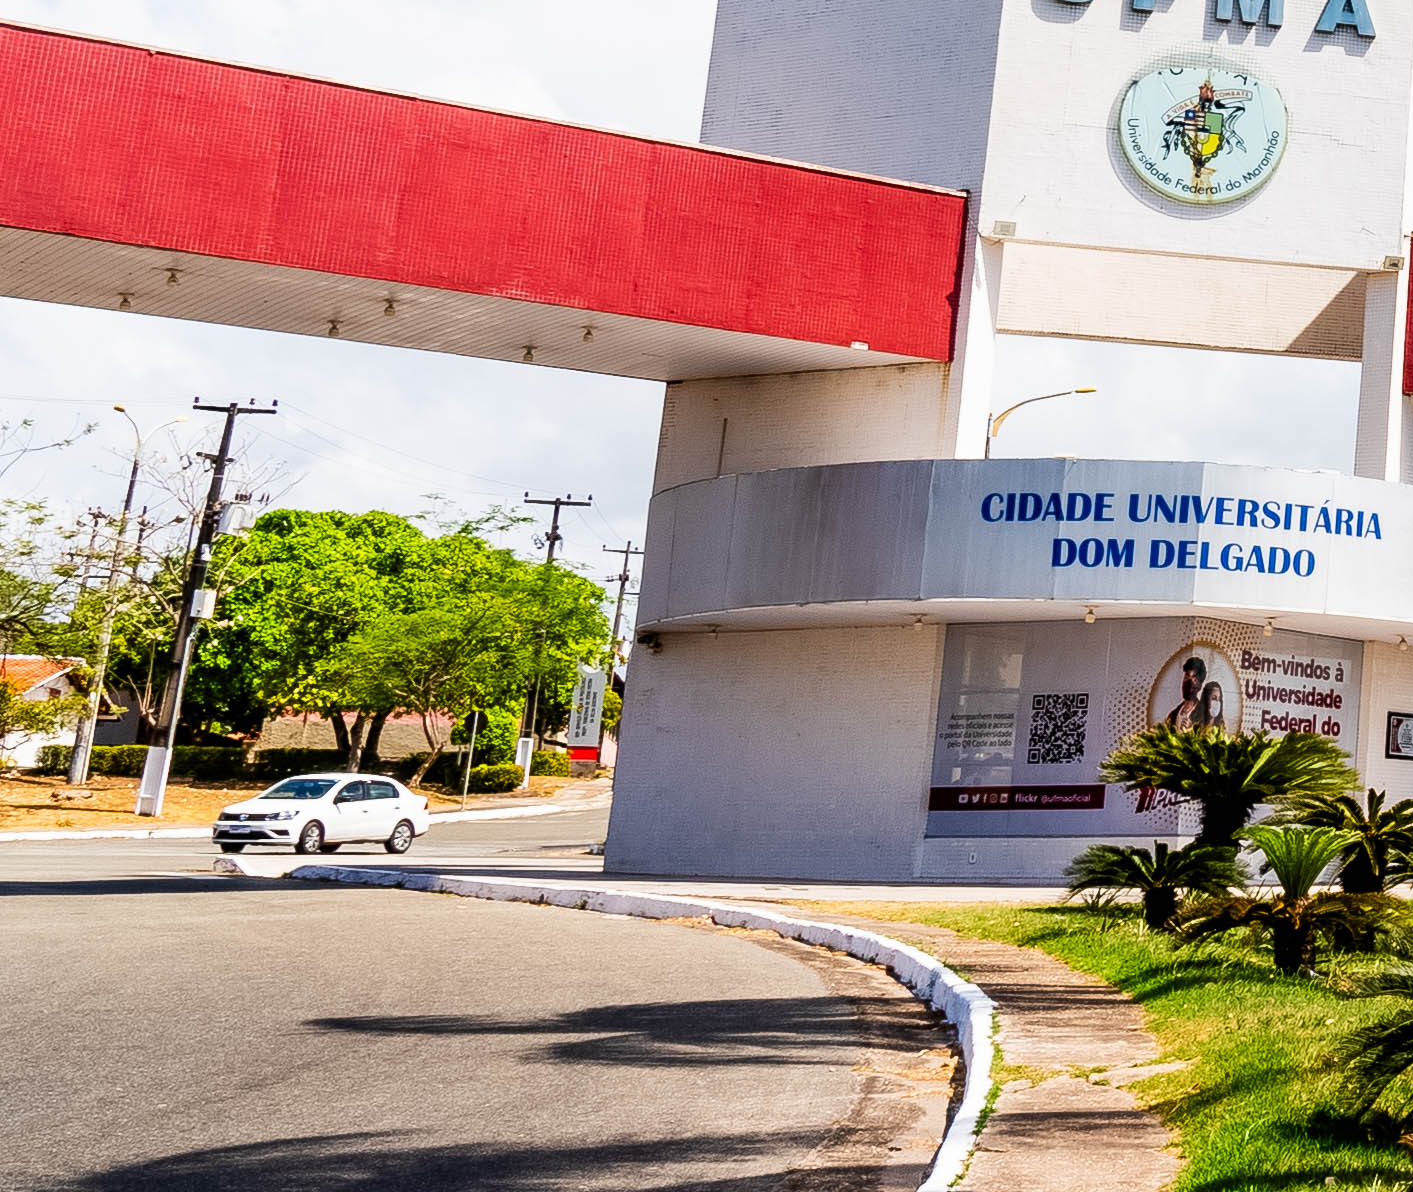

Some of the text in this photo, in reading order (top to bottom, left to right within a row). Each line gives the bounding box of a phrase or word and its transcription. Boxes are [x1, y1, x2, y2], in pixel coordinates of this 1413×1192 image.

[1127, 118, 1280, 195] Universidade Federal do Maranhão
[981, 492, 1383, 540] CIDADE UNIVERSITÁRIA
[1051, 537, 1316, 578] DOM DELGADO
[1240, 649, 1344, 683] Bem-vindos à
[1244, 678, 1343, 710] Universidade
[1260, 710, 1341, 737] Federal do
[1015, 792, 1038, 803] flickr
